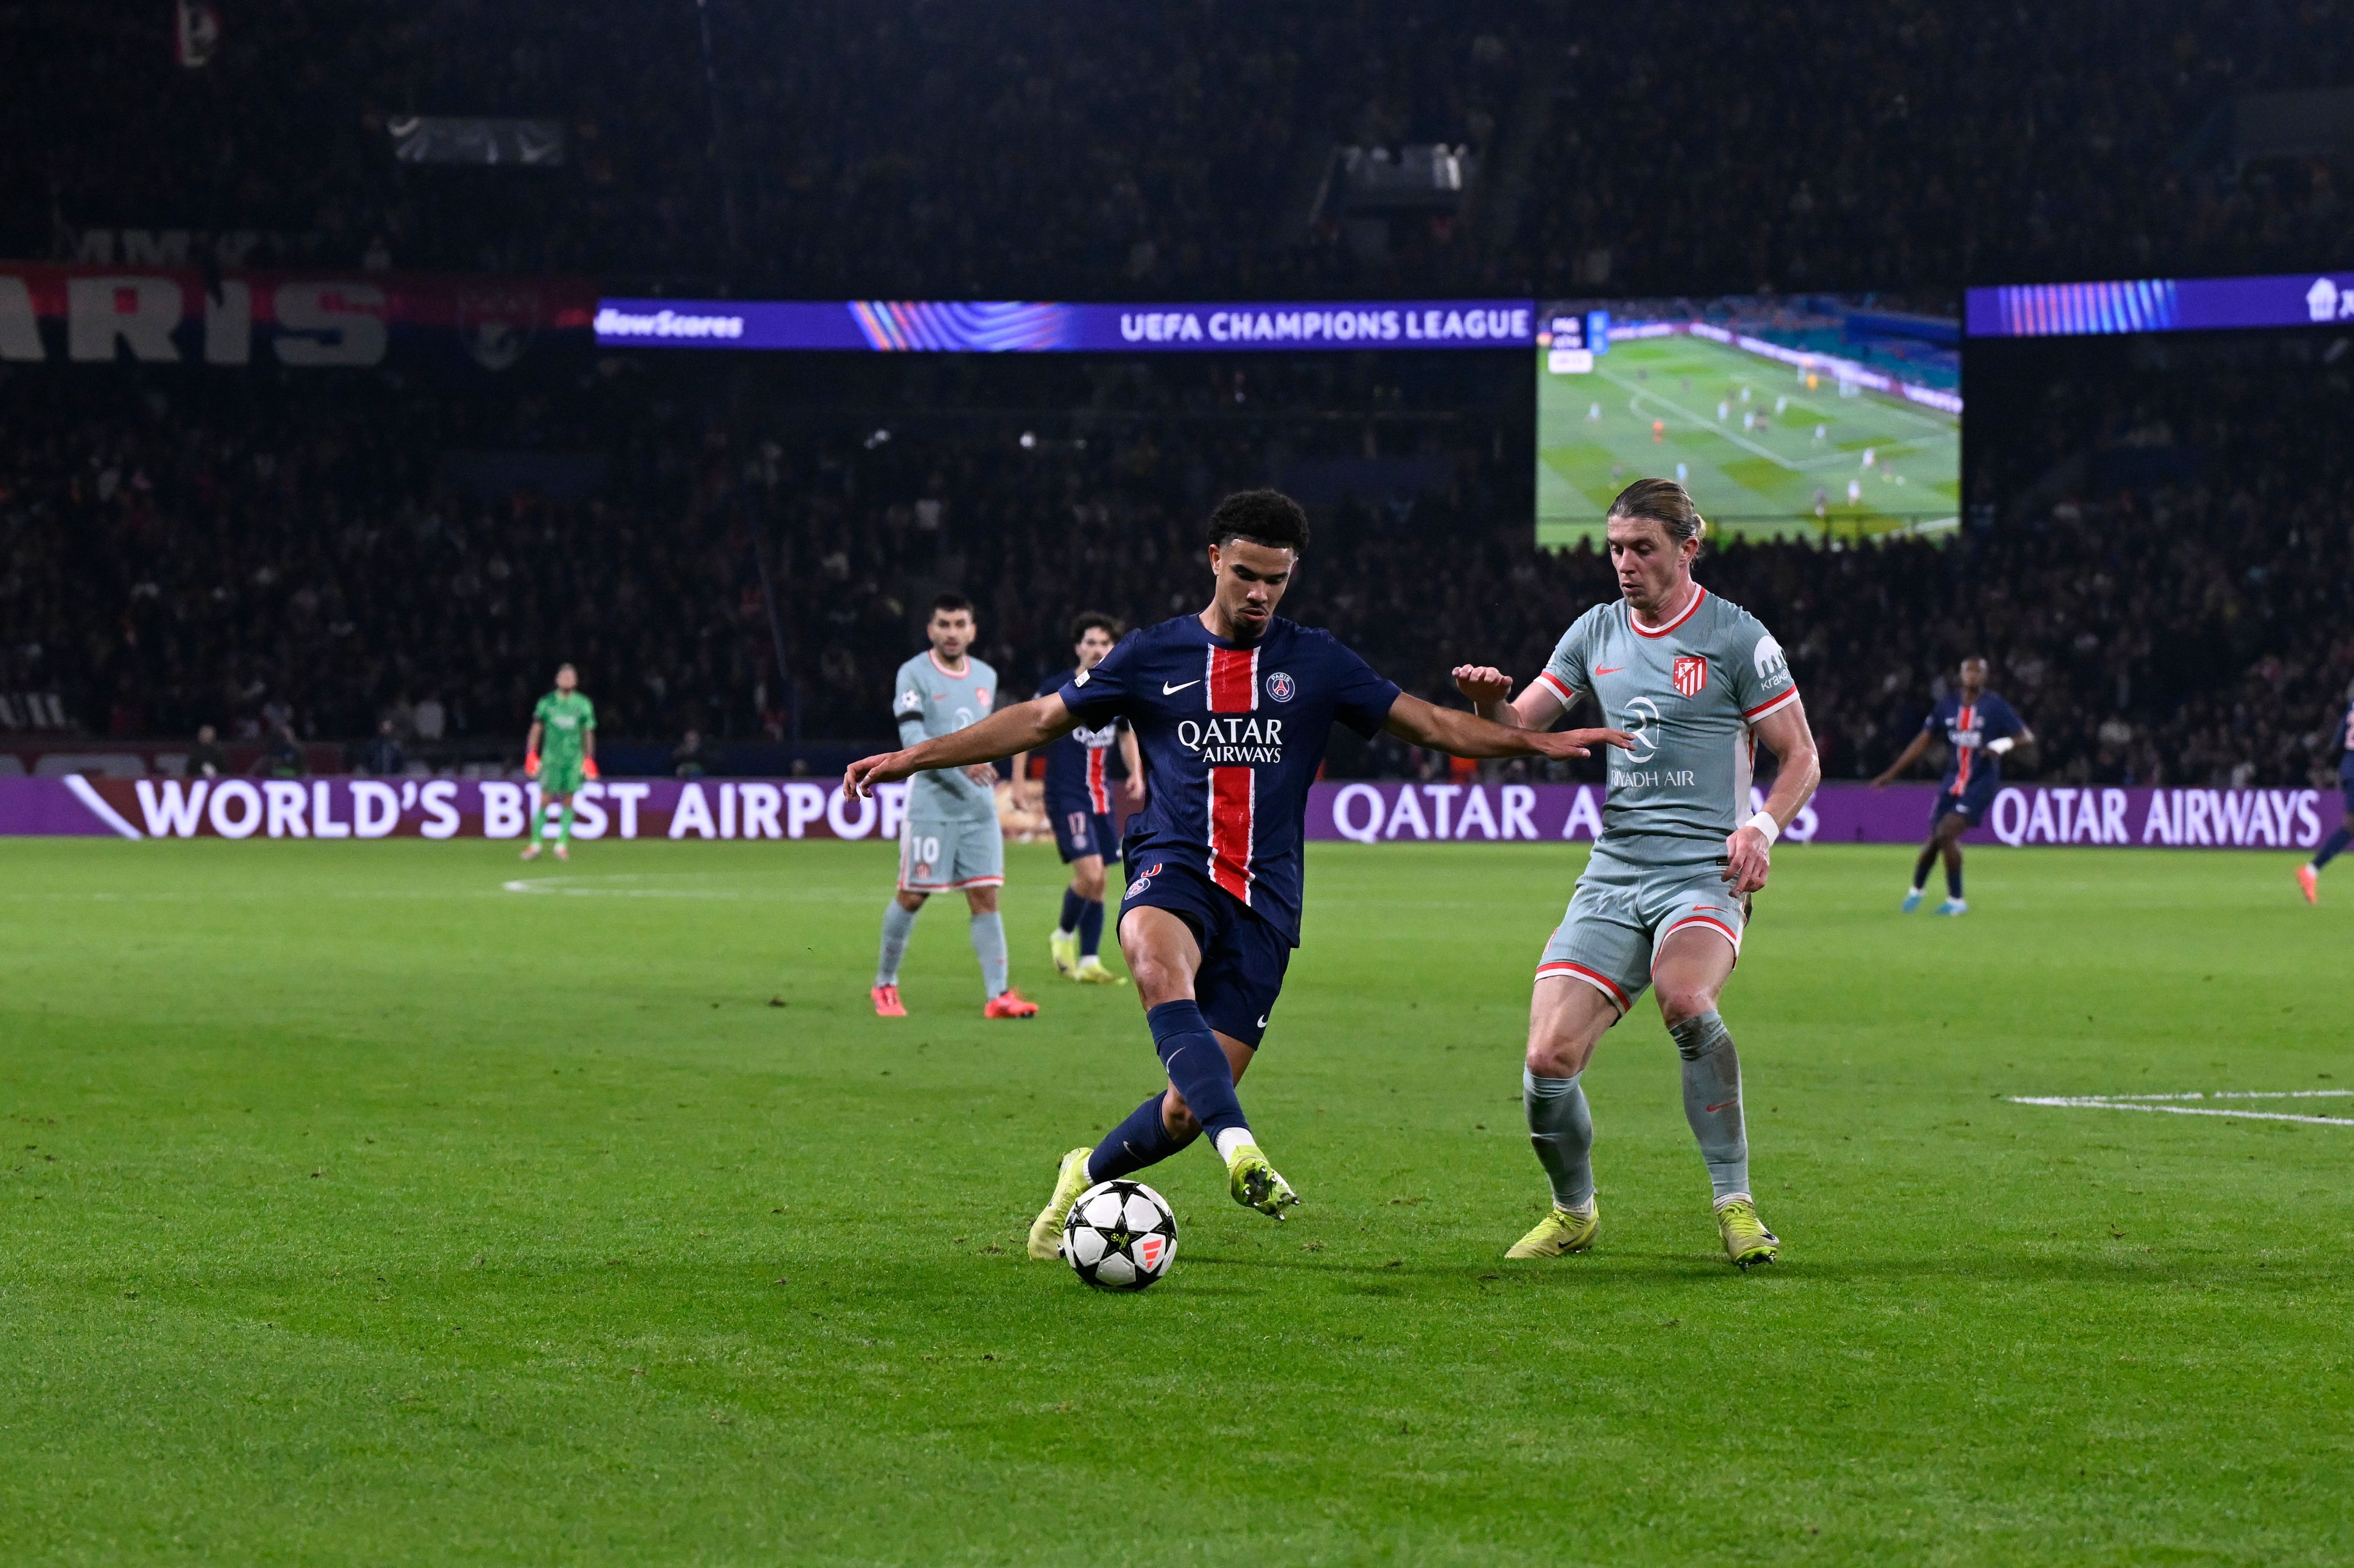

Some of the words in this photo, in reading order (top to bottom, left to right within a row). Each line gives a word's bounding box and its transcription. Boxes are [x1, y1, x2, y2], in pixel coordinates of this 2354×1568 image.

[1120, 313, 1202, 341] UEFA
[1208, 311, 1400, 340] CHAMPIONS
[1406, 309, 1528, 339] LEAGUE
[1271, 674, 1290, 682] PARIS
[1761, 668, 1790, 691] krake
[1177, 718, 1283, 752] QATAR
[1202, 746, 1281, 764] AIRWAYS
[1611, 770, 1659, 788] RIYADH
[1664, 770, 1695, 786] AIR
[134, 780, 461, 839] WORLD'S
[1333, 783, 1539, 844] QATAR
[1991, 788, 2129, 847] QATAR
[2142, 788, 2322, 847] AIRWAYS
[912, 836, 940, 863] 10
